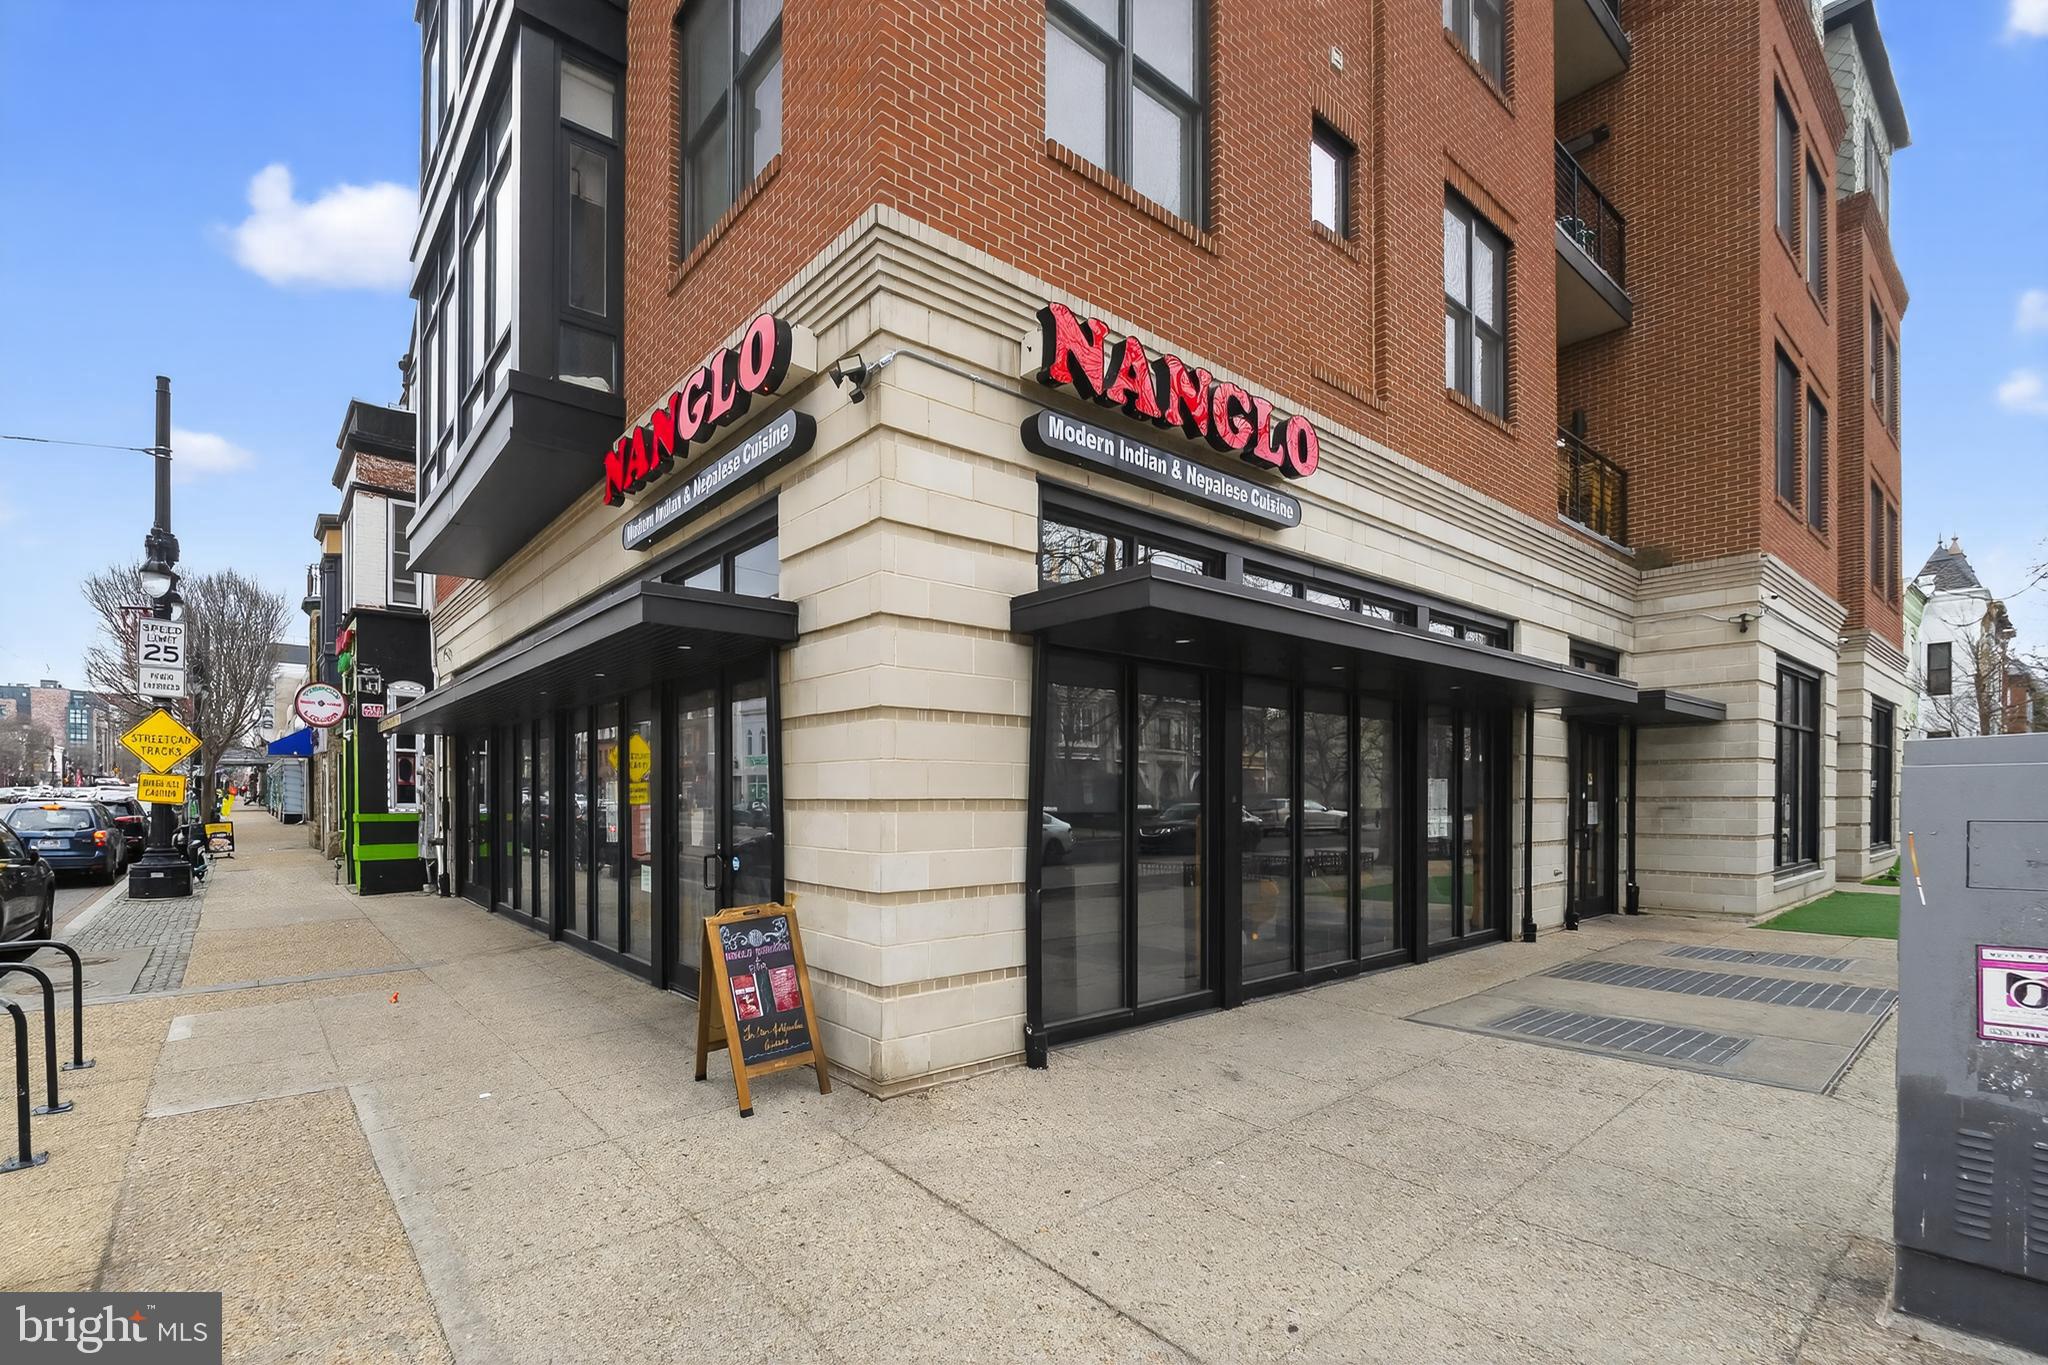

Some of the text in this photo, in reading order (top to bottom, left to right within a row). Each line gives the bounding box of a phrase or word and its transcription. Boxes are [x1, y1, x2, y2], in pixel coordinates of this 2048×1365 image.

[604, 312, 784, 506] NANGLO
[1042, 301, 1320, 478] NANGLO
[683, 486, 691, 505] &
[693, 455, 741, 499] Nepalese
[742, 423, 789, 465] Cuisine
[1048, 415, 1294, 519] Modern Indian & Nepalese Cuisine
[142, 623, 183, 635] SPEED
[143, 644, 180, 663] 25
[141, 745, 182, 757] TRACKS
